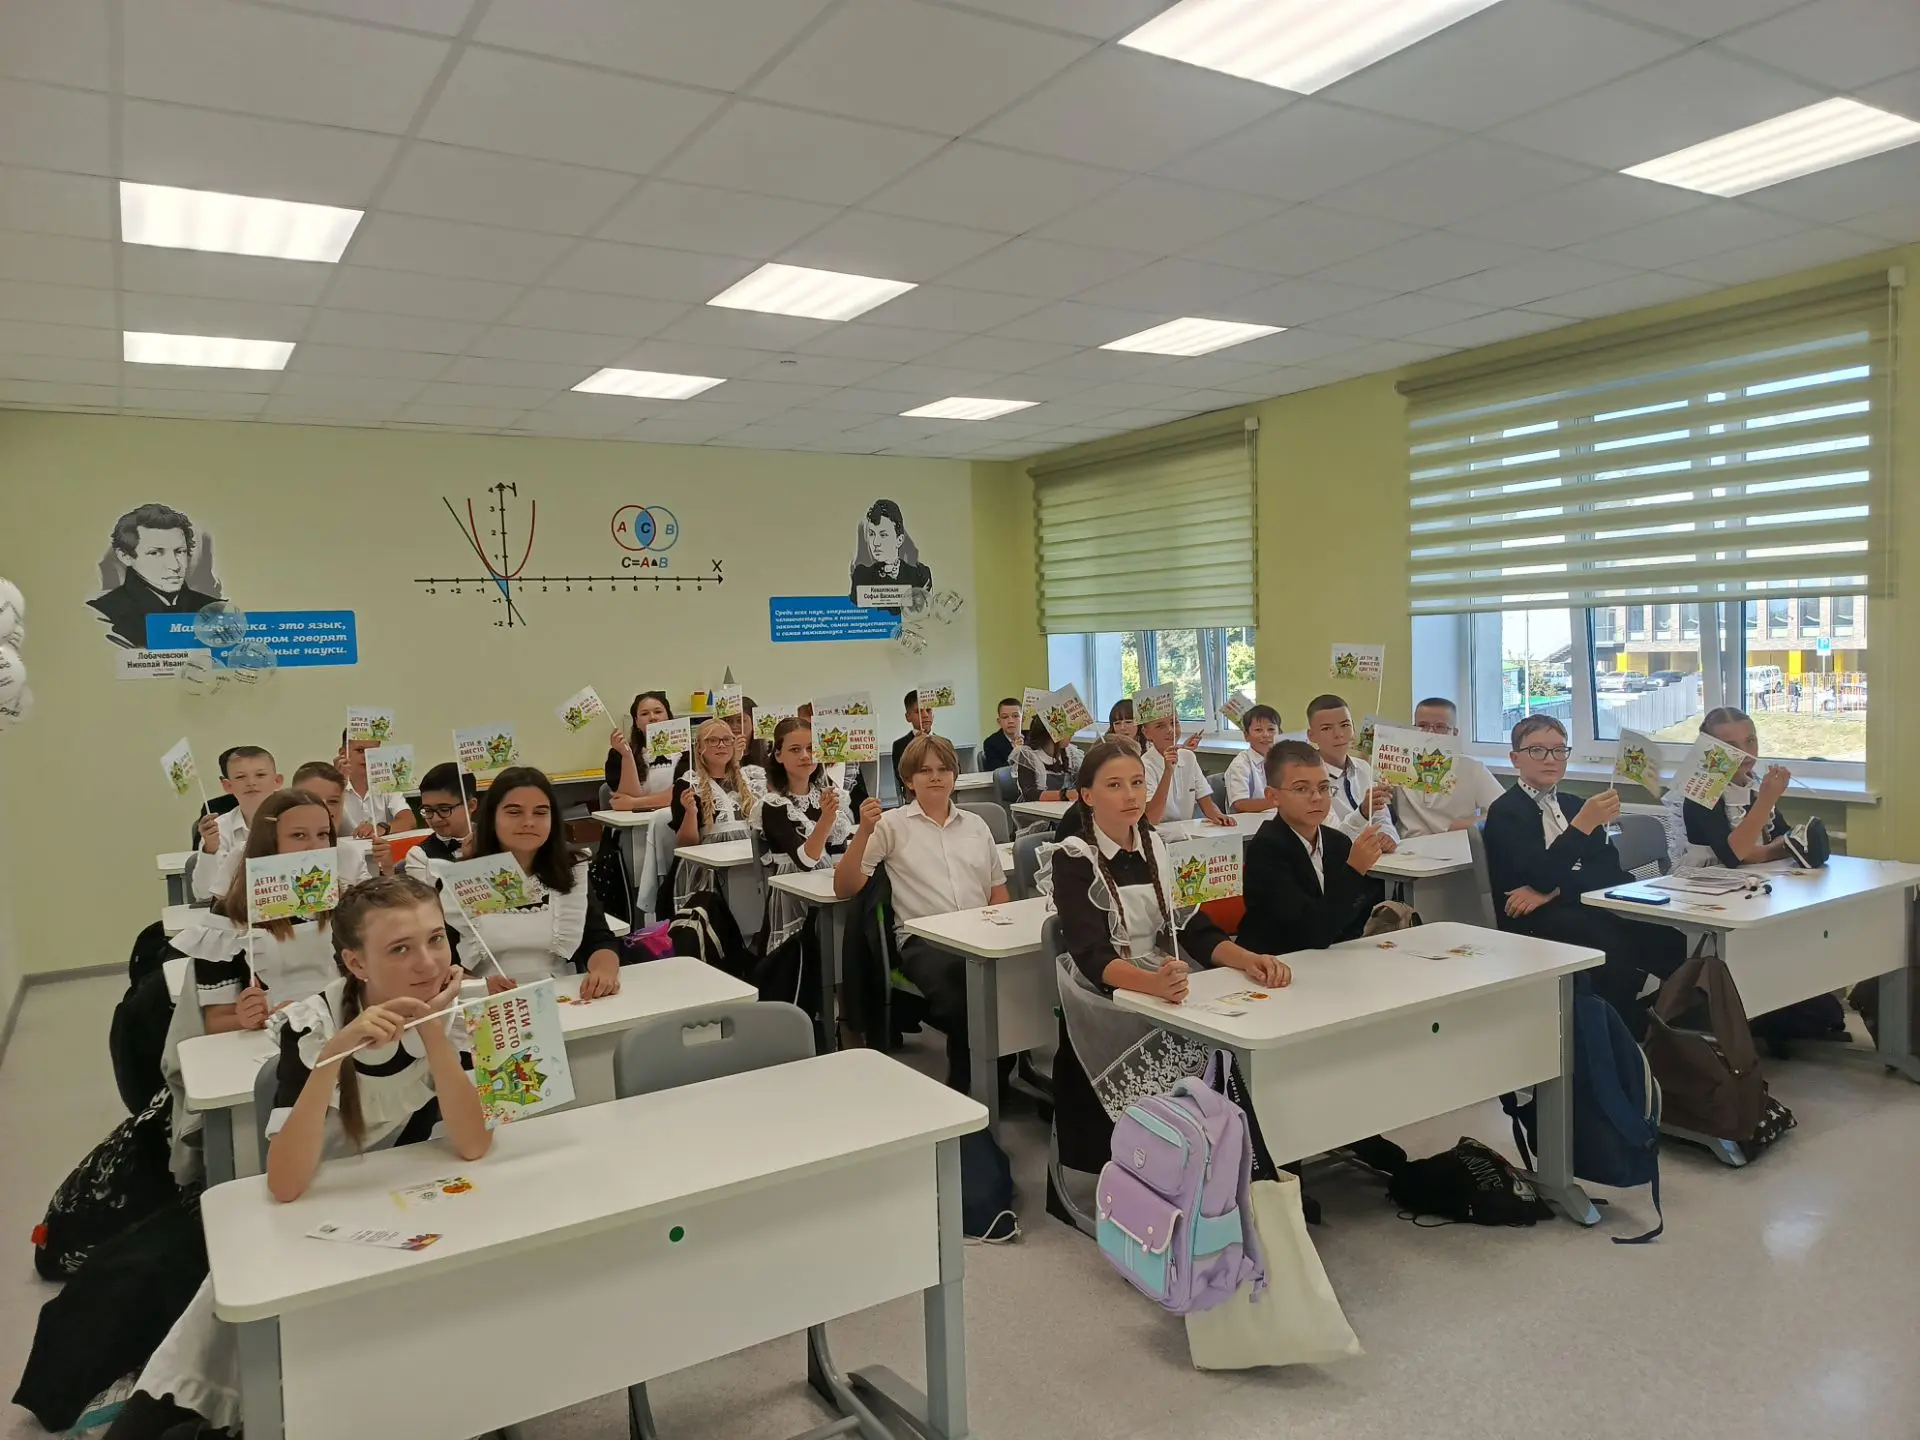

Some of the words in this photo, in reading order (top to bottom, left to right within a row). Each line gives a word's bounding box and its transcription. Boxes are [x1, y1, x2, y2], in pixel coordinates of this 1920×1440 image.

[616, 521, 627, 532] A
[640, 522, 651, 534] C
[665, 524, 675, 535] B
[712, 559, 722, 573] X
[278, 623, 305, 631] это
[307, 621, 346, 631] язык,
[229, 635, 289, 646] отором
[292, 634, 347, 644] говорят
[138, 651, 189, 660] Лобачевский
[304, 646, 347, 656] науки.
[127, 660, 160, 669] Николай
[849, 743, 874, 751] ЦВЕТОВ
[1379, 743, 1400, 753] ДЕТИ
[1379, 752, 1410, 765] ВМЕСТО
[1378, 762, 1407, 773] ЦВЕТОВ
[1208, 855, 1228, 866] ДЕТИ
[1208, 863, 1239, 875] ВМЕСТО
[254, 875, 277, 887] ДЕТИ
[453, 878, 474, 890] ДЕТИ
[1209, 873, 1237, 885] ЦВЕТОВ
[254, 883, 290, 896] ВМЕСТО
[457, 883, 489, 897] ВМЕСТО
[255, 893, 289, 907] ЦВЕТОВ
[462, 891, 492, 906] ЦВЕТОВ
[516, 997, 532, 1028] ДЕТИ
[488, 1004, 506, 1051] ЦВЕТОВ
[502, 1000, 521, 1049] ВМЕСТО
